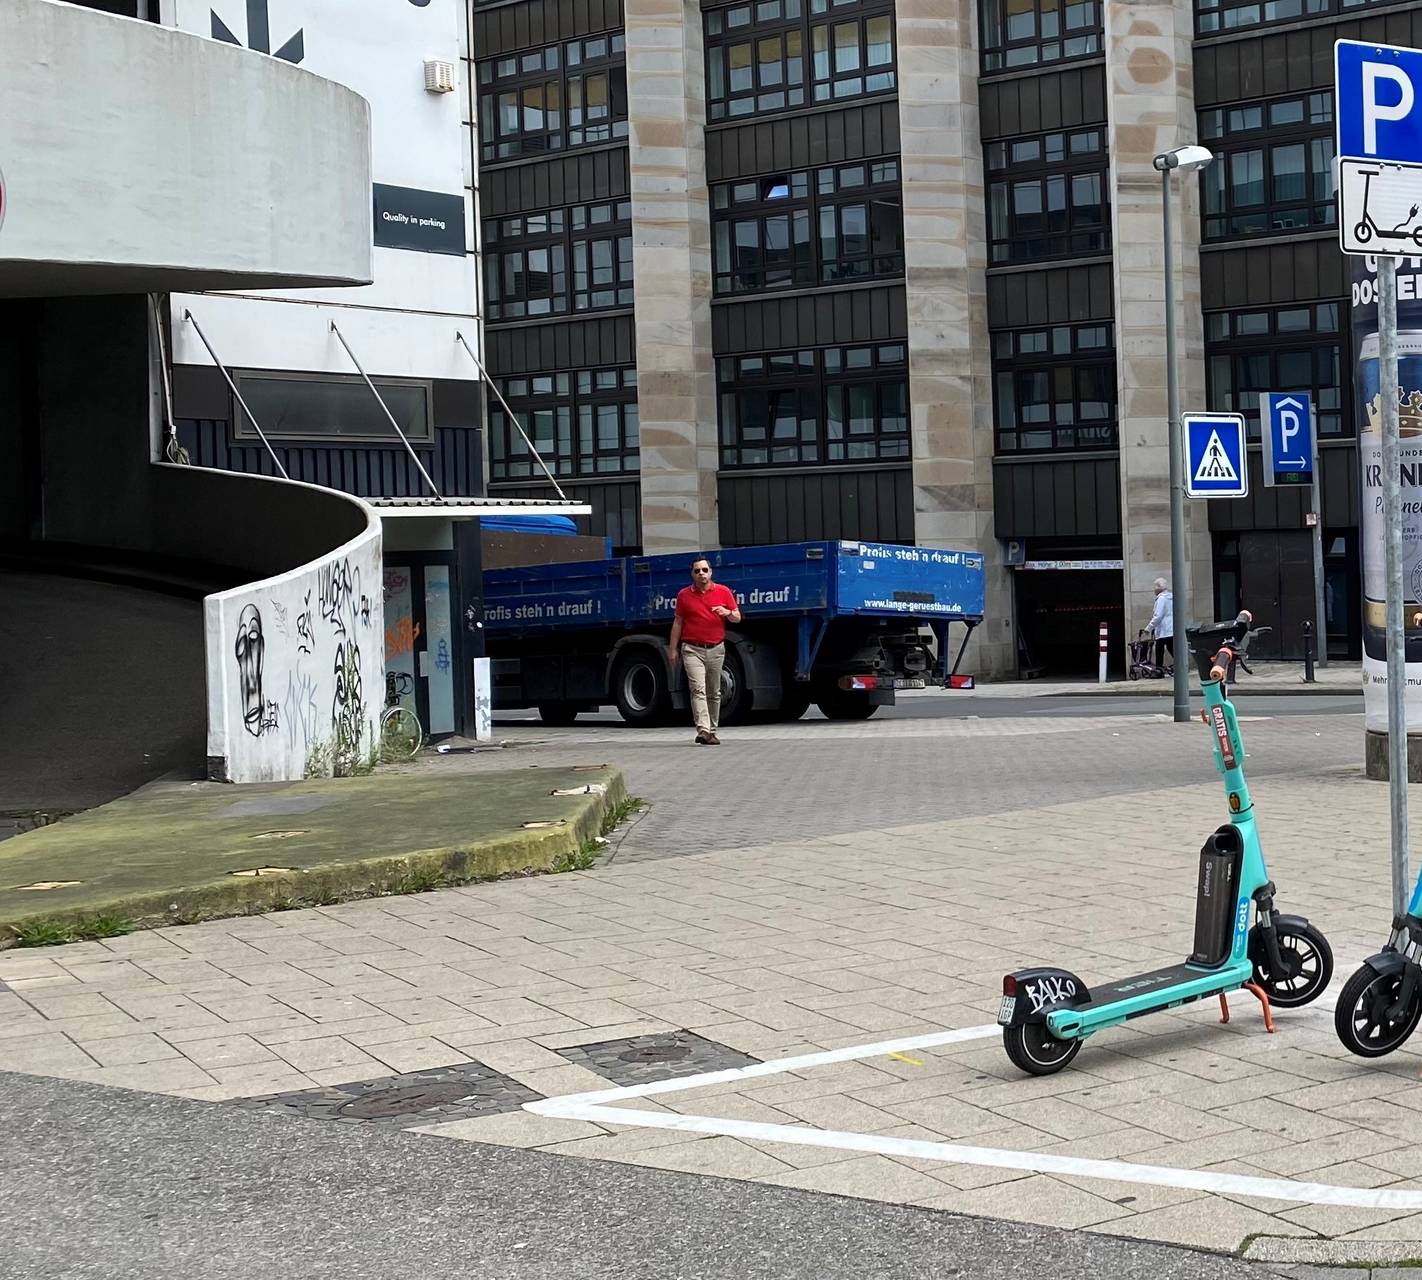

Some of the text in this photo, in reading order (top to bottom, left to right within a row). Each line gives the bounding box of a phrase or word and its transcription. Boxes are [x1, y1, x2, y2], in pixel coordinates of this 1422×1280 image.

[1362, 61, 1415, 155] P
[383, 211, 446, 230] Quality in parking
[1280, 410, 1300, 453] P
[1008, 541, 1020, 561] P
[750, 586, 790, 604] drauf
[557, 600, 593, 616] drauf
[863, 599, 962, 613] www.lange-geruestbau.de
[1212, 707, 1228, 737] GRATIS
[1239, 901, 1248, 932] dott
